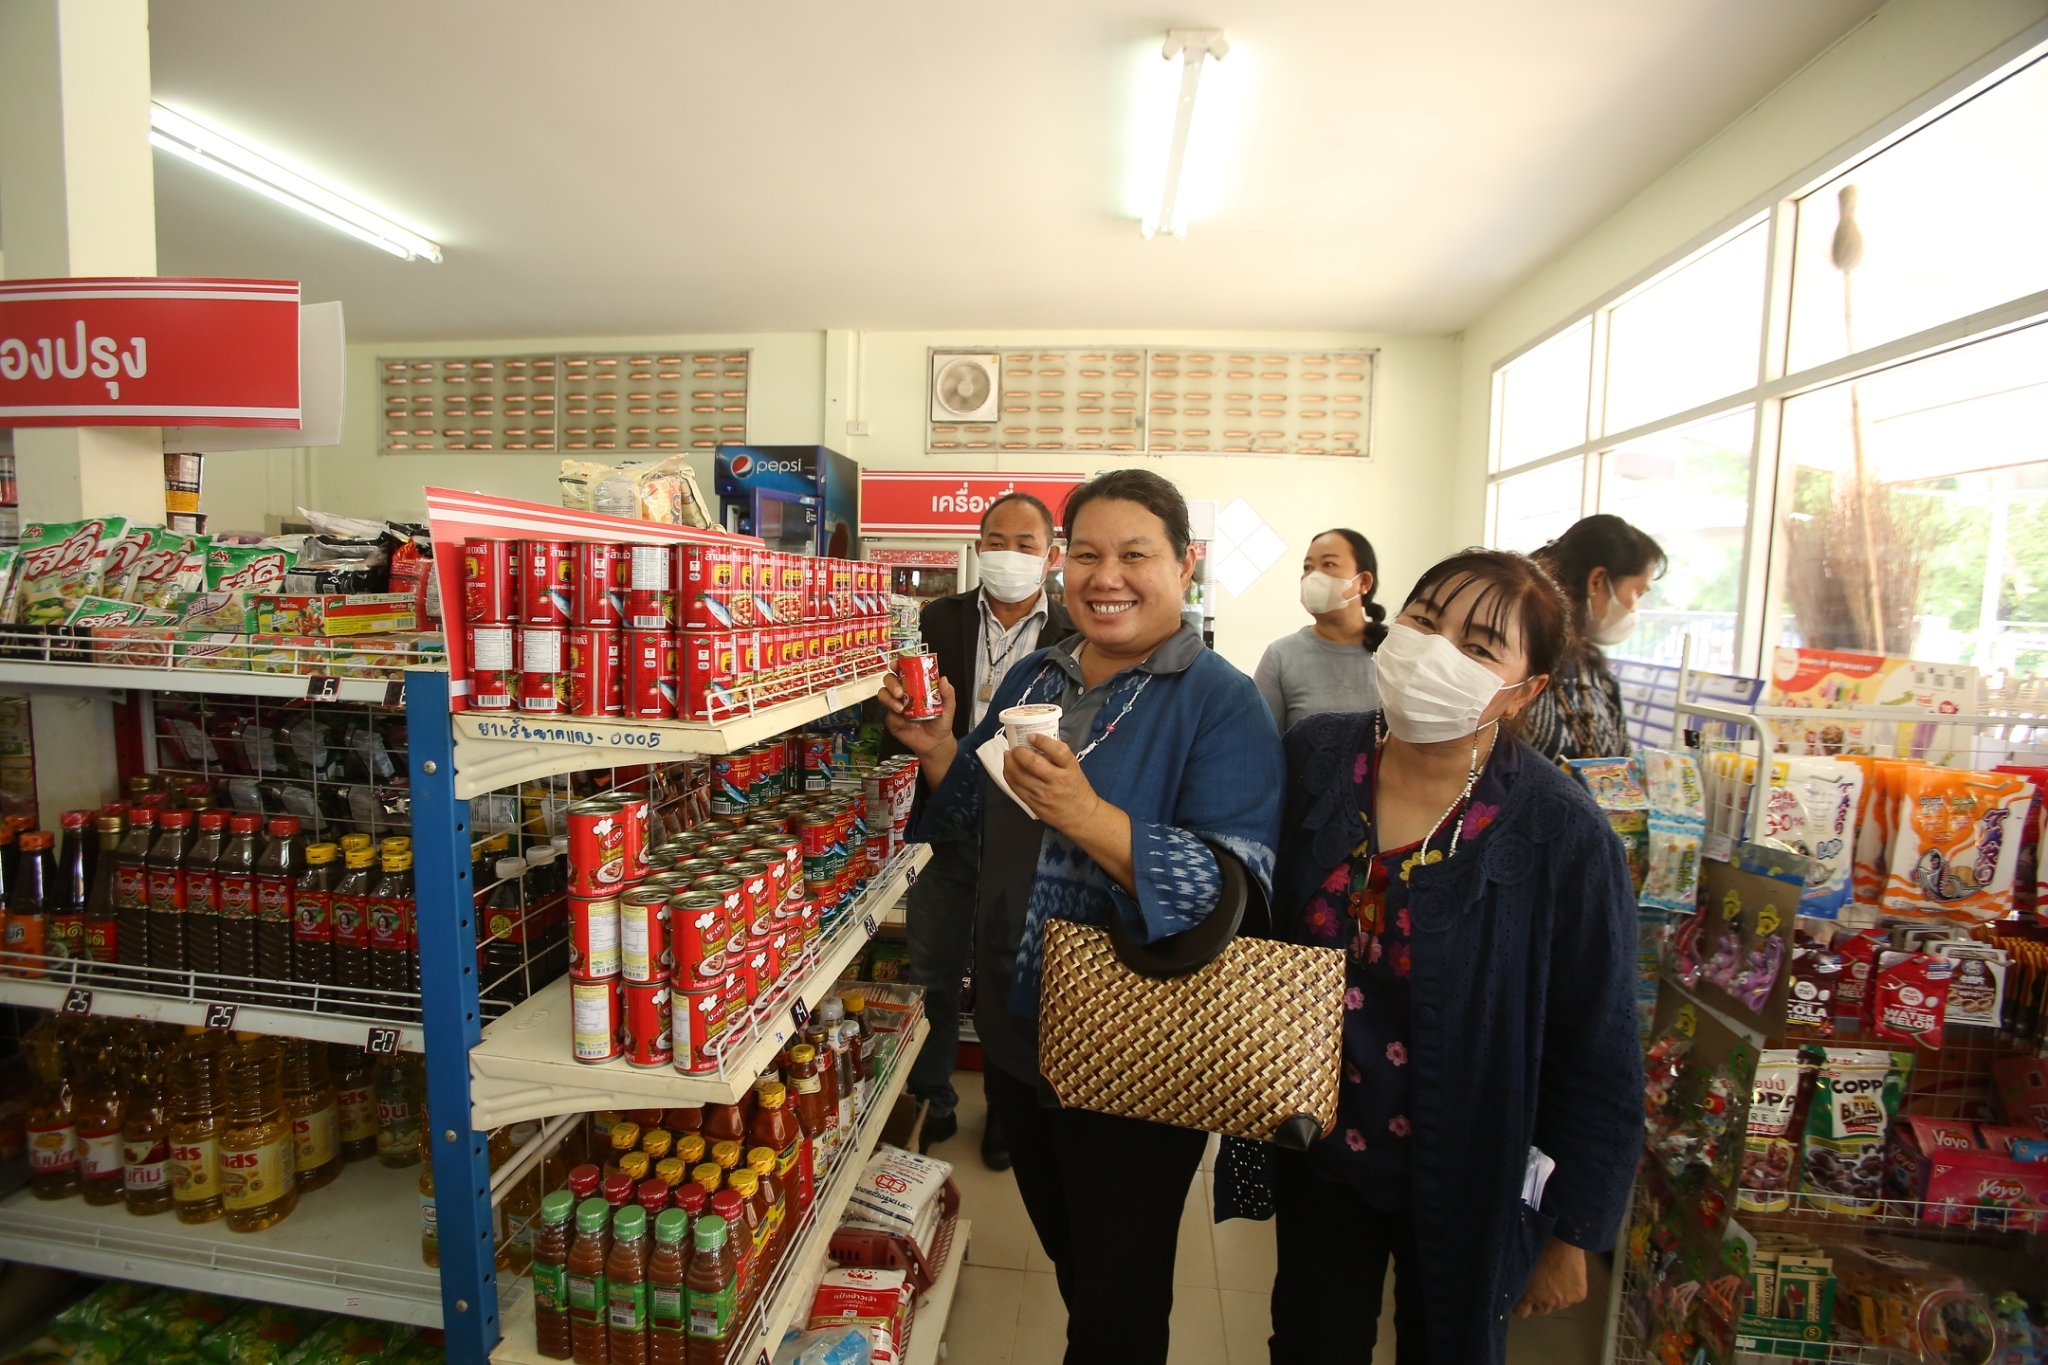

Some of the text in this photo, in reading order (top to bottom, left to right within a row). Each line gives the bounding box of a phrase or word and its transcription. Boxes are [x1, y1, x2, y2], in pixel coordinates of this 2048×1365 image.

[756, 459, 801, 475] pepsi
[321, 679, 334, 699] 6
[610, 733, 661, 748] 0005
[1974, 807, 2010, 886] TARO
[67, 991, 89, 1011] 25
[210, 1006, 232, 1027] 25
[1789, 1013, 1821, 1023] LEMON
[1883, 1007, 1936, 1023] WATER
[1883, 1014, 1936, 1031] MELON
[372, 1031, 396, 1051] 20
[1831, 1079, 1884, 1094] COPP
[1978, 1178, 2022, 1197] Yoyo
